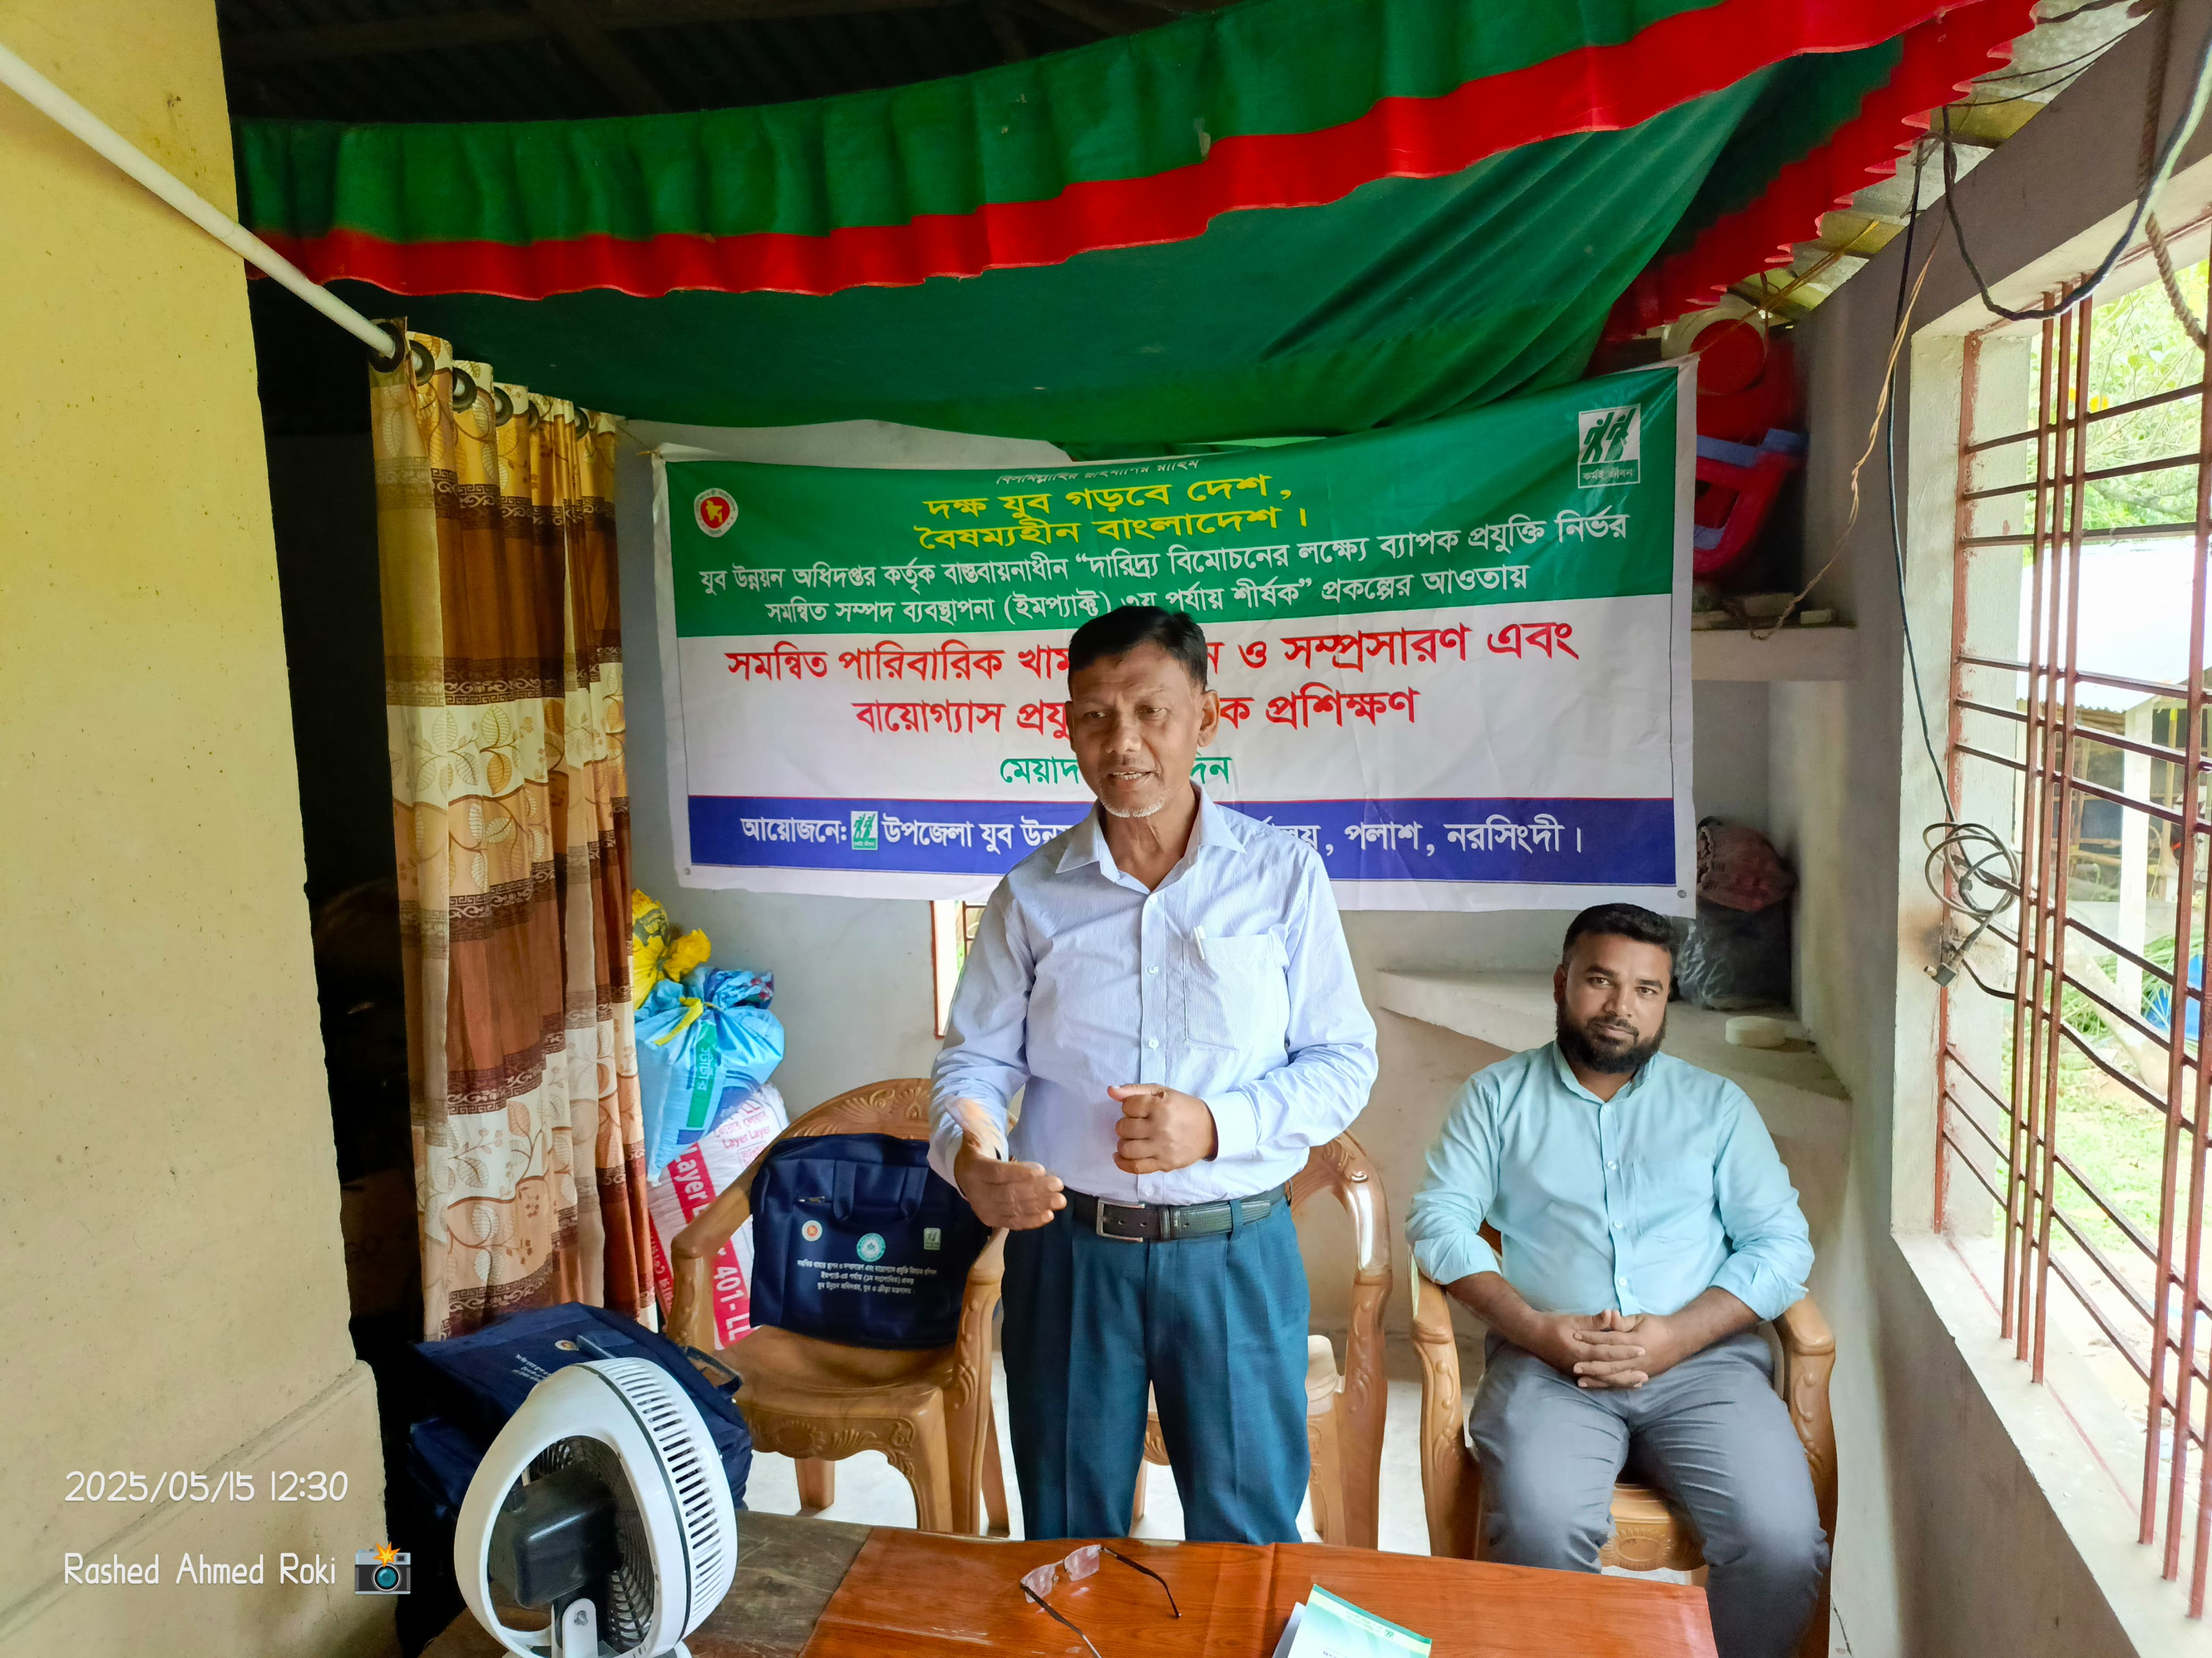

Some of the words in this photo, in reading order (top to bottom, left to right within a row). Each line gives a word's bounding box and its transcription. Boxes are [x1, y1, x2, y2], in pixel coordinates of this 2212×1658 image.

[924, 498, 988, 519] দক্ষ
[998, 493, 1052, 520] যুব
[1066, 485, 1171, 512] গড়বে
[699, 571, 727, 594] যুব
[732, 563, 786, 591] উন্নয়ন
[792, 561, 877, 587] অধিদপ্তর
[881, 557, 936, 595] কর্তৃক
[941, 551, 1069, 585] বাস্তবায়নাধীন
[1166, 544, 1291, 575] বিমোচনের
[1296, 537, 1370, 564] লক্ষ্যে
[1377, 530, 1461, 559] ব্যাপক
[1468, 514, 1547, 554] প্রযুক্তি
[1554, 506, 1630, 543] নির্ভর
[914, 517, 1080, 551] বৈষম্যহীন
[765, 596, 830, 622] সমন্বিত
[834, 602, 896, 622] সম্পদ
[901, 599, 995, 626] ব্যবস্থাপনা
[1165, 582, 1225, 612] পর্যায়
[1321, 575, 1414, 603] প্রকল্পের
[1421, 564, 1531, 594] আওতায়
[725, 642, 828, 681] সমন্বিত
[838, 639, 1006, 681] পারিবারিক
[1238, 642, 1267, 668] ও
[1279, 622, 1472, 673] সম্প্রসারণ
[1487, 622, 1579, 660] এবং
[852, 699, 1007, 733] বায়োগ্যাস
[1266, 683, 1421, 730] প্রশিক্ষণ
[881, 813, 975, 847] উপজেলা
[978, 823, 1015, 855] যুব
[722, 1134, 748, 1149] Layer
[749, 1125, 770, 1139] Layer
[673, 1146, 708, 1200] Layer
